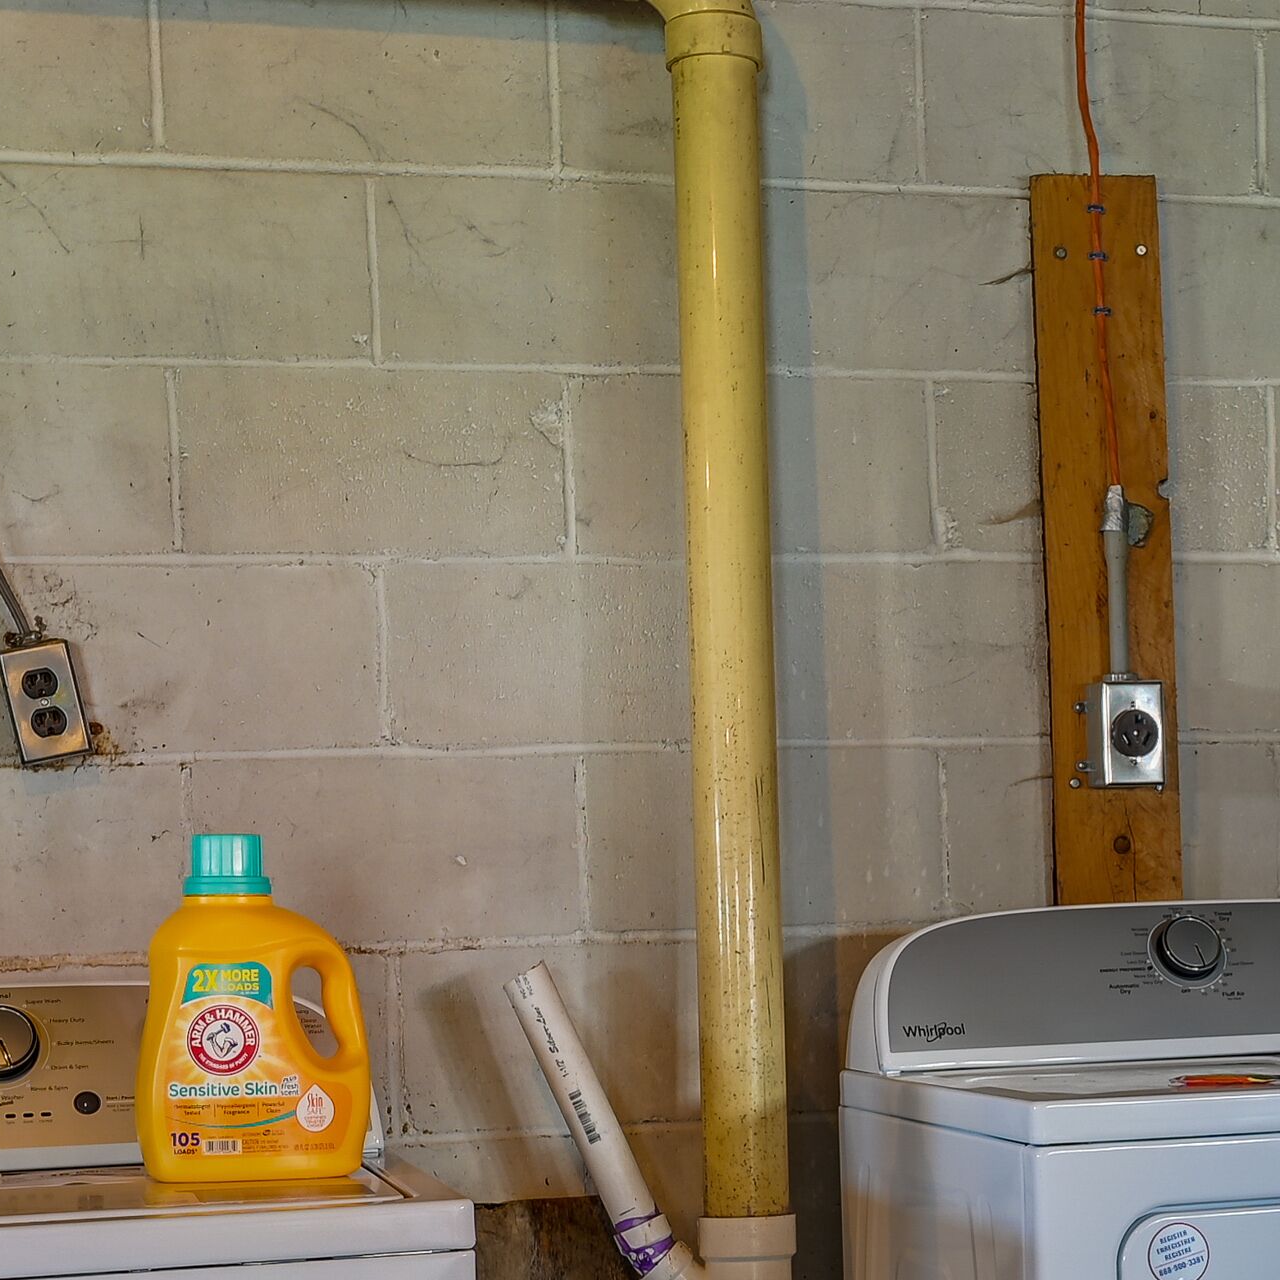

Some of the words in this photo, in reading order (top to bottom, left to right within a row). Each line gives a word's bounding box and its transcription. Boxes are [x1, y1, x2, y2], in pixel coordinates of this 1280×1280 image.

[192, 969, 219, 992] 2X
[222, 969, 260, 982] MORE
[192, 1019, 208, 1048] ARM
[205, 1012, 217, 1022] &
[216, 1009, 256, 1047] HAMMER
[902, 1022, 966, 1042] Whirlpool
[169, 1083, 240, 1097] Sensitive
[245, 1082, 277, 1095] Skin
[307, 1093, 323, 1111] Skin
[171, 1132, 201, 1147] 105
